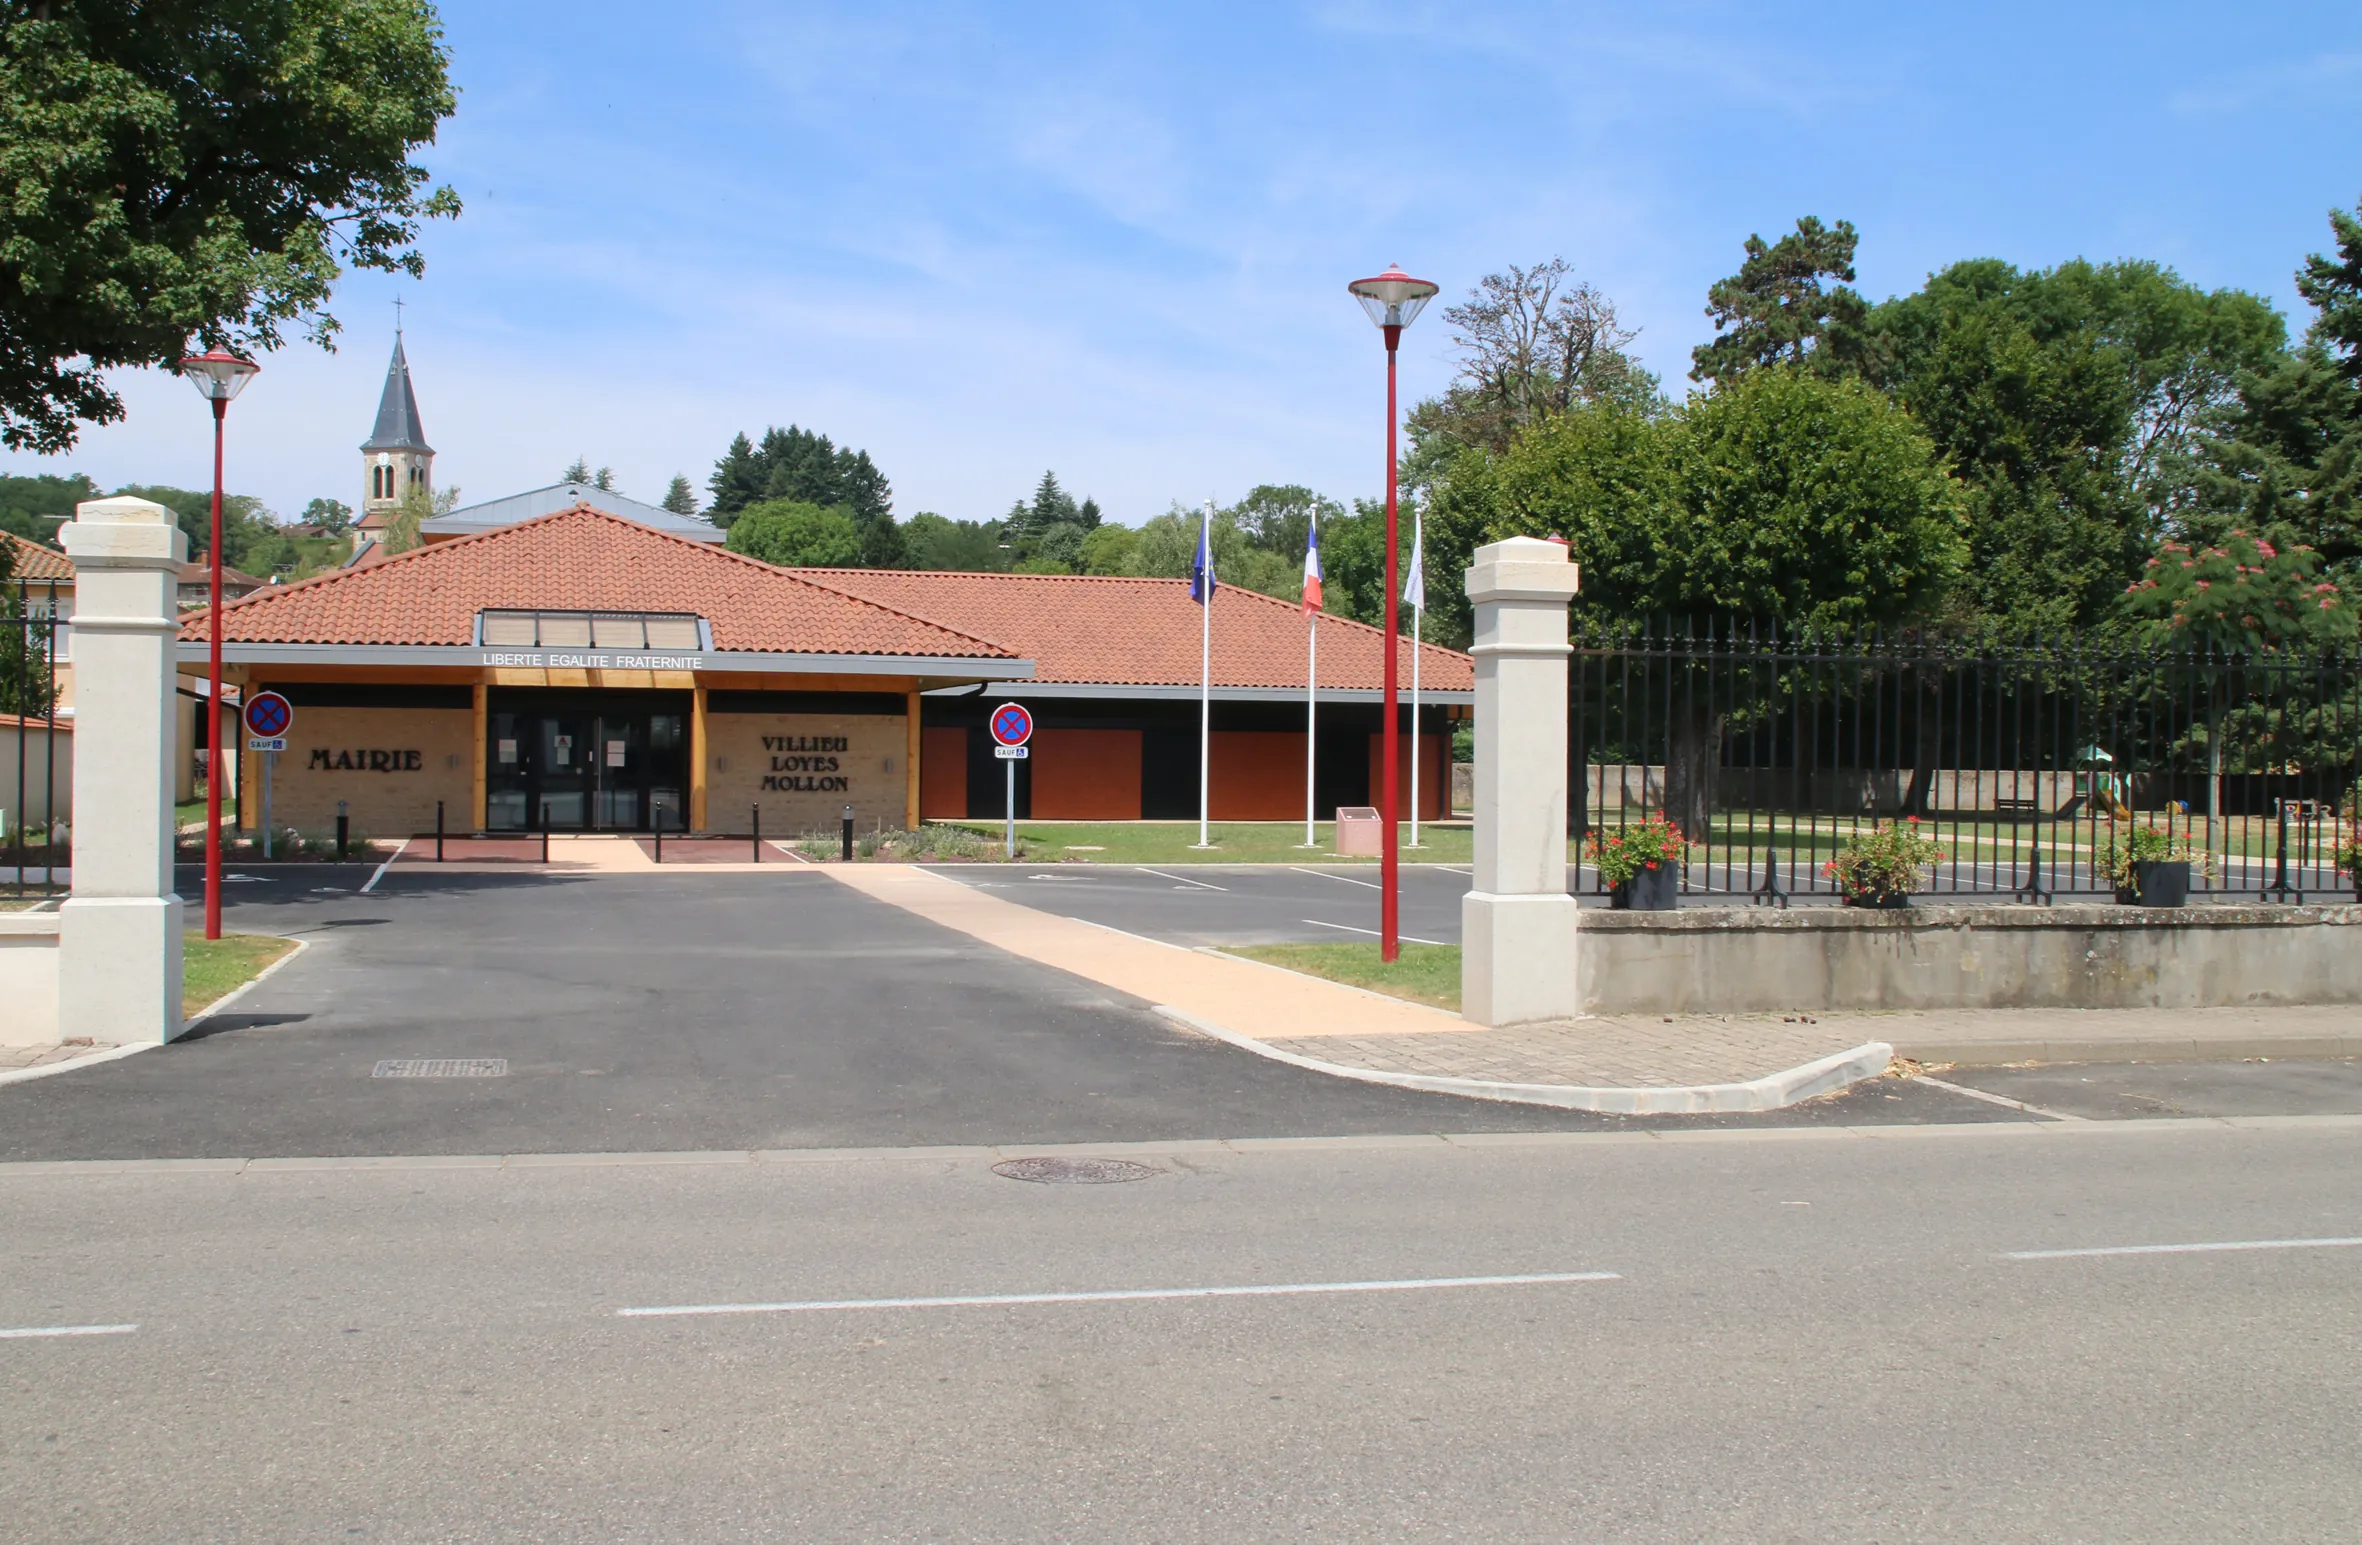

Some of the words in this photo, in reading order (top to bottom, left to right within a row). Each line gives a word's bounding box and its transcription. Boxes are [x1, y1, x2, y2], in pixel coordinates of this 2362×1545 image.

[483, 653, 542, 666] LIBERTE
[550, 654, 609, 667] EGALITE
[616, 656, 702, 669] FRATERNITE
[761, 736, 848, 752] VILLIEU
[308, 749, 422, 772] MAIRIE
[771, 756, 839, 772] LOYES
[761, 776, 848, 791] MOLLON
